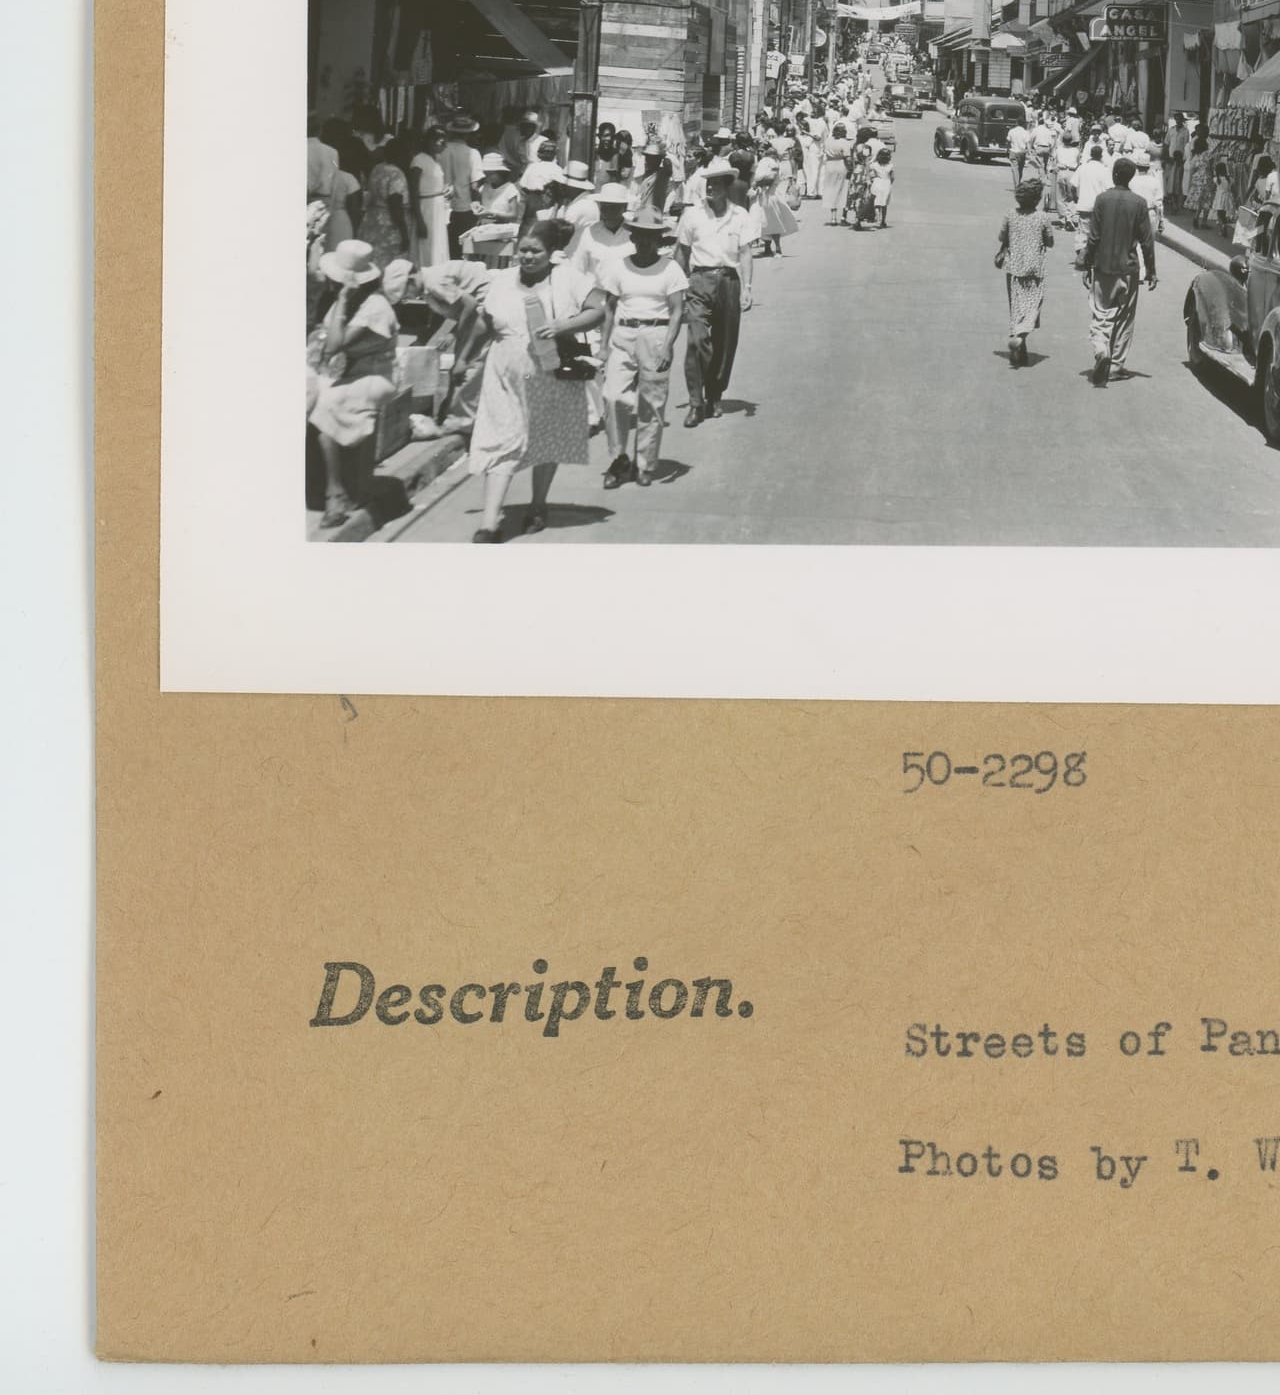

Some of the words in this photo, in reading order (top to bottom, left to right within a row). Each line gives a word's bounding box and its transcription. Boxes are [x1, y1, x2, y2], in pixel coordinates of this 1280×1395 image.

[1101, 24, 1160, 38] ANGEL
[1108, 8, 1158, 21] CASA
[902, 750, 1087, 795] 50-2298
[308, 956, 755, 1038] Description.
[905, 1022, 1087, 1059] Streets
[1119, 1021, 1173, 1057] of
[897, 1139, 1059, 1181] Photos
[1089, 1145, 1148, 1190] by
[1175, 1138, 1220, 1182] T.
